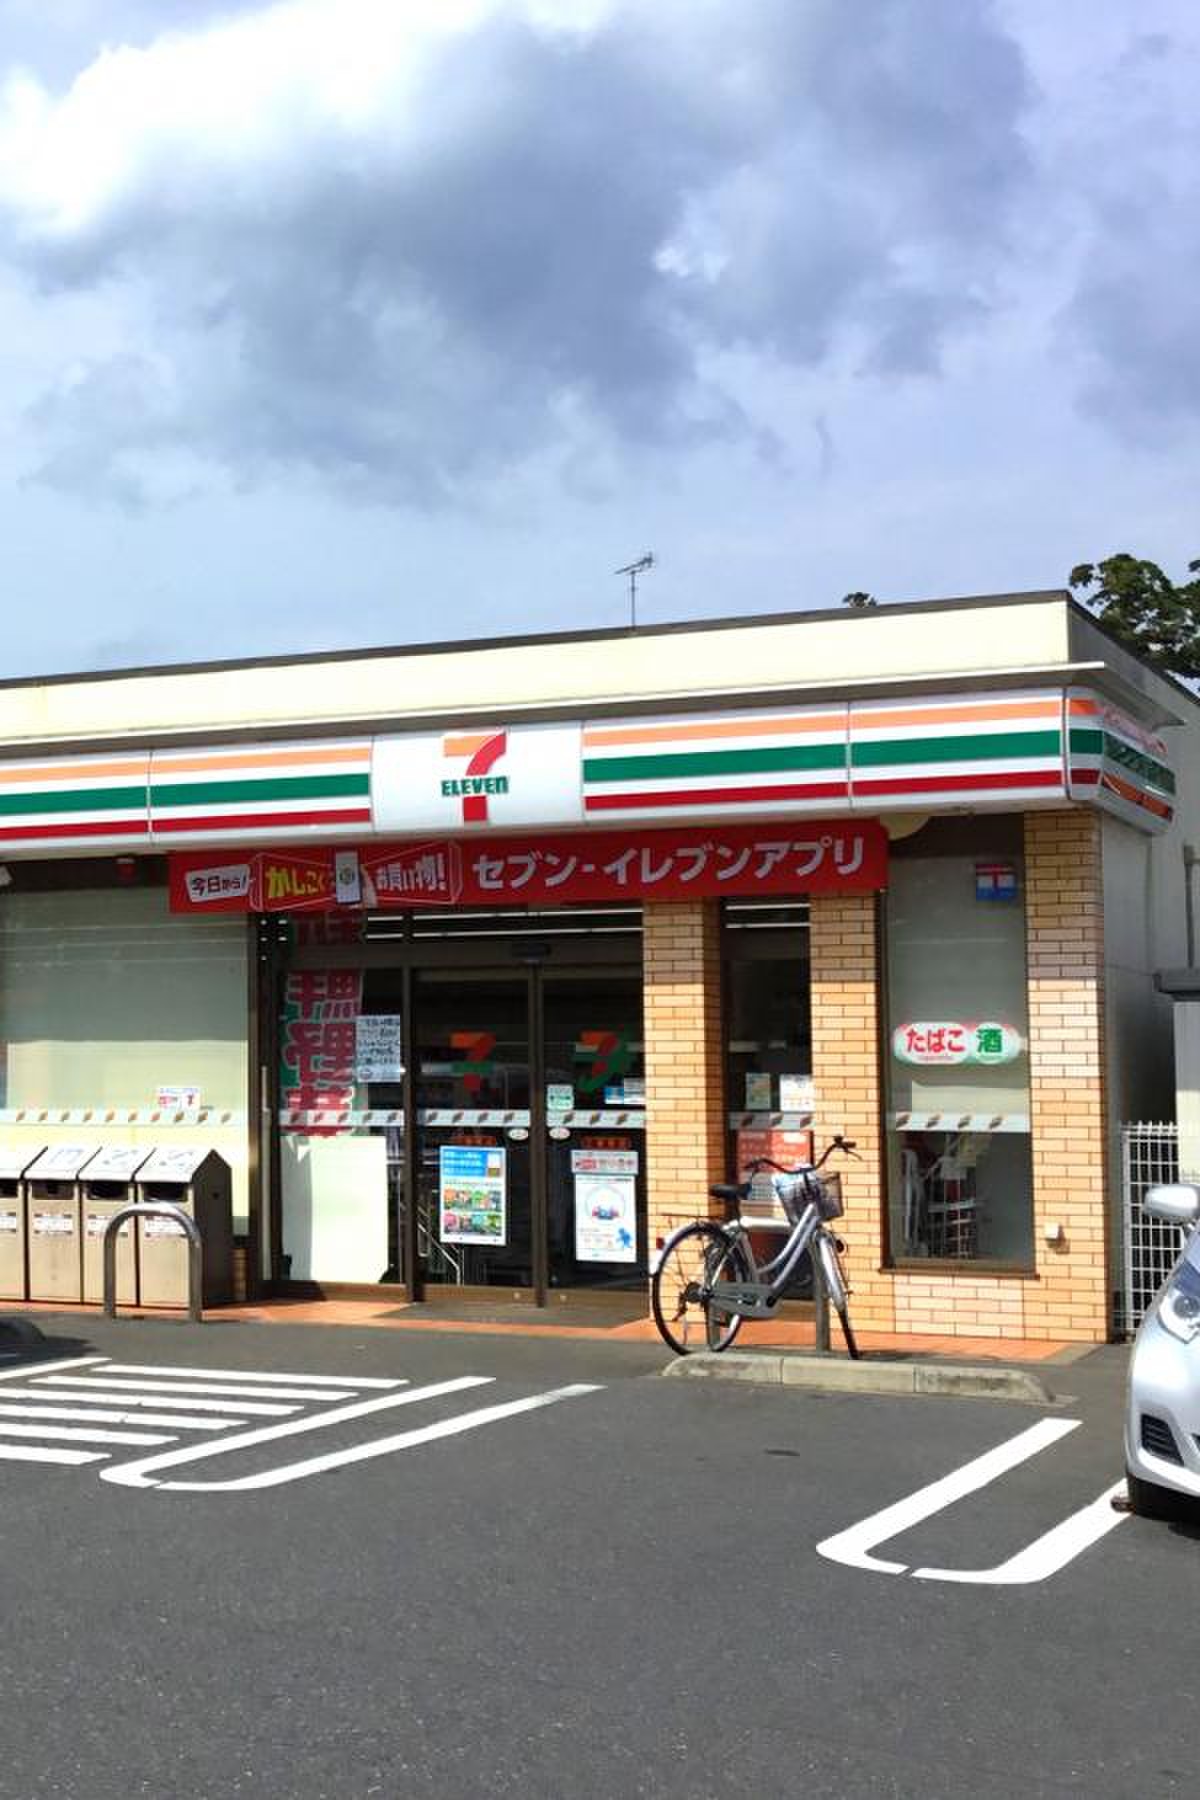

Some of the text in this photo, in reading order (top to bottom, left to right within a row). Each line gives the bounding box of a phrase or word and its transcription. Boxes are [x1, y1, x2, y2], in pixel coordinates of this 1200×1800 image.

[906, 1028, 1003, 1053] たばこ 酒
